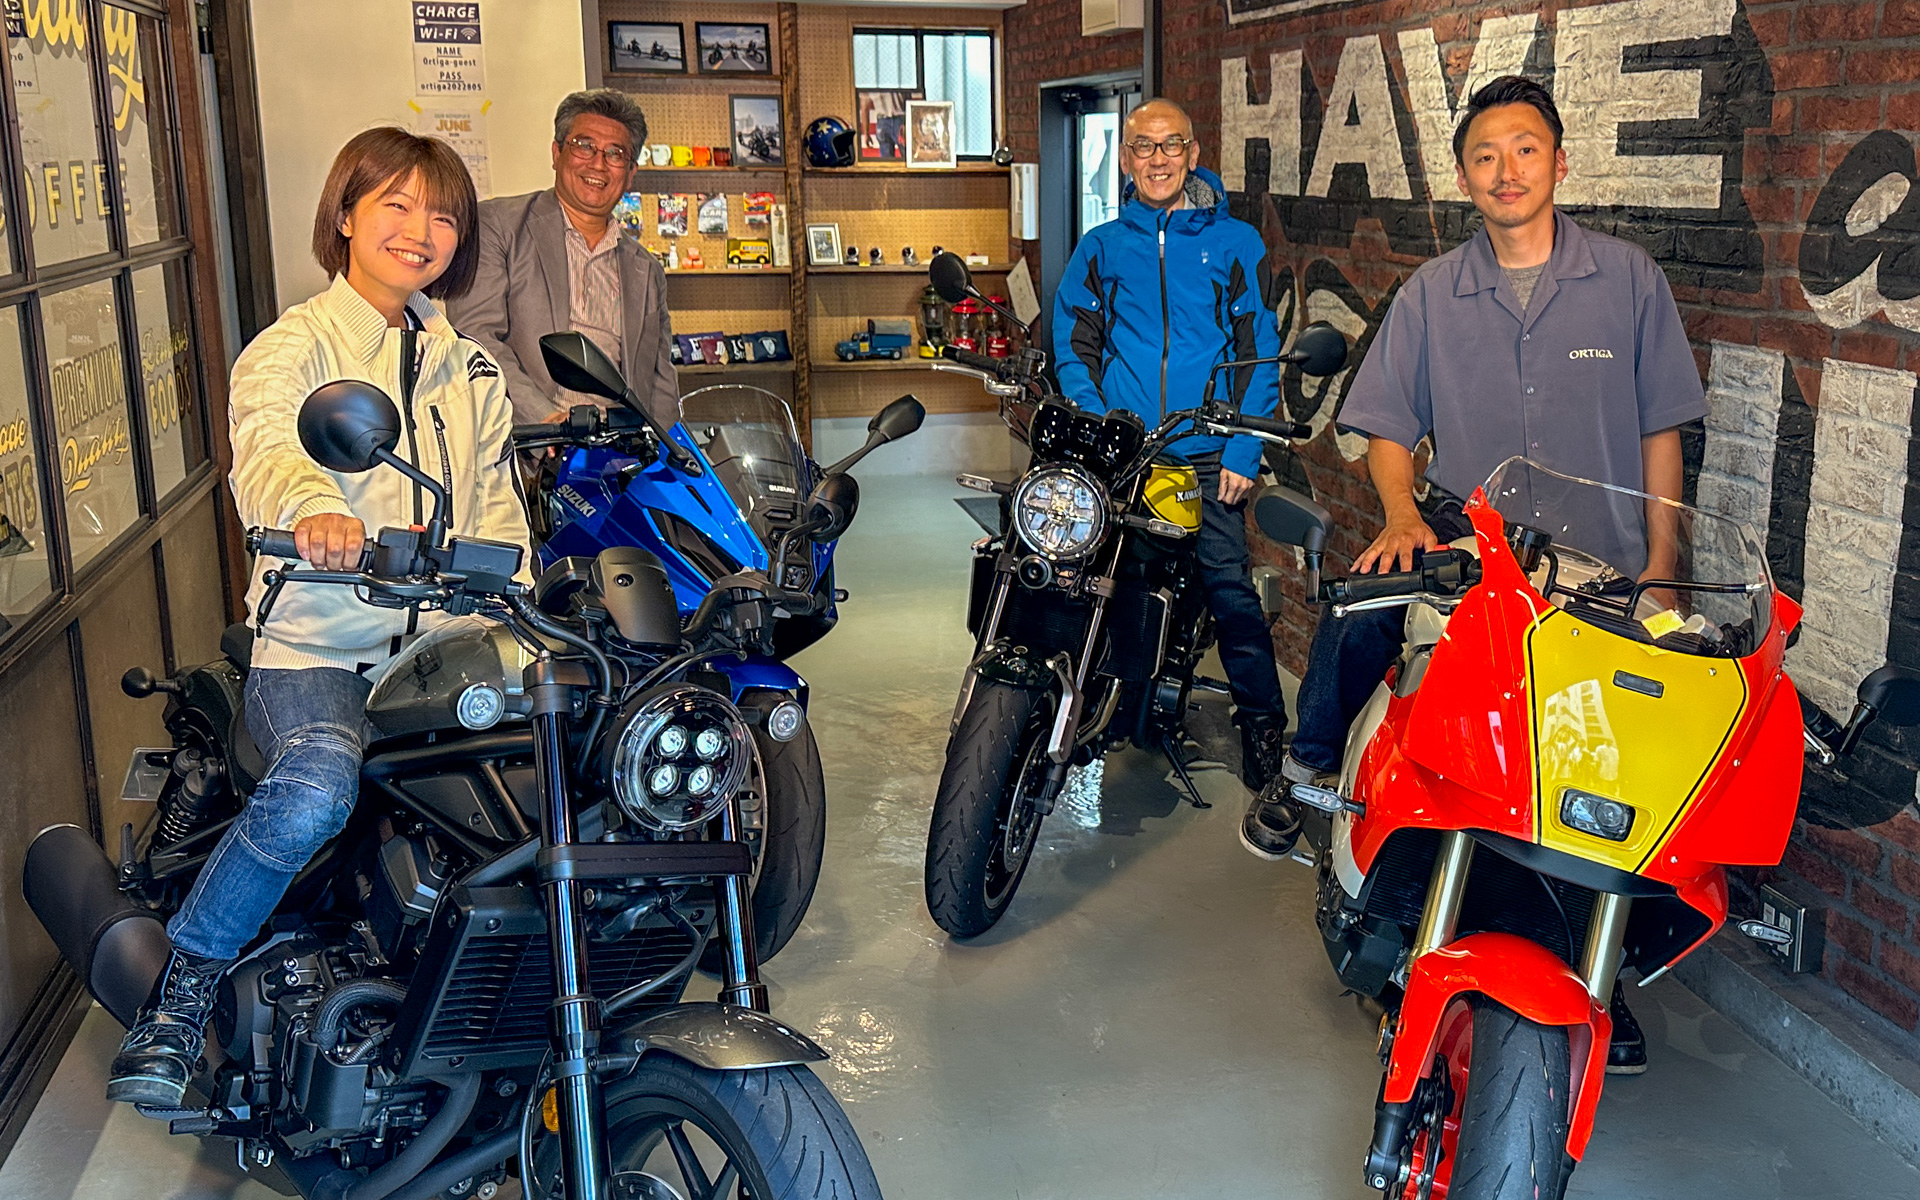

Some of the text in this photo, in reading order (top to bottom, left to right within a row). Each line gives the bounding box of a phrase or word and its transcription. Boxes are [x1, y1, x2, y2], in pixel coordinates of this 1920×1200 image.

[416, 5, 476, 19] CHARGE
[420, 27, 458, 40] Wi-Fi
[436, 47, 462, 56] NAME
[440, 72, 462, 80] PASS
[1220, 0, 1742, 209] HAVE
[436, 119, 472, 133] JUNE
[1568, 348, 1614, 360] ORTIGA
[52, 340, 126, 437] PREMIUM
[148, 358, 193, 441] FOODS
[61, 411, 129, 498] Quality
[768, 484, 796, 495] SUZUKI
[557, 484, 597, 518] SUZUKI
